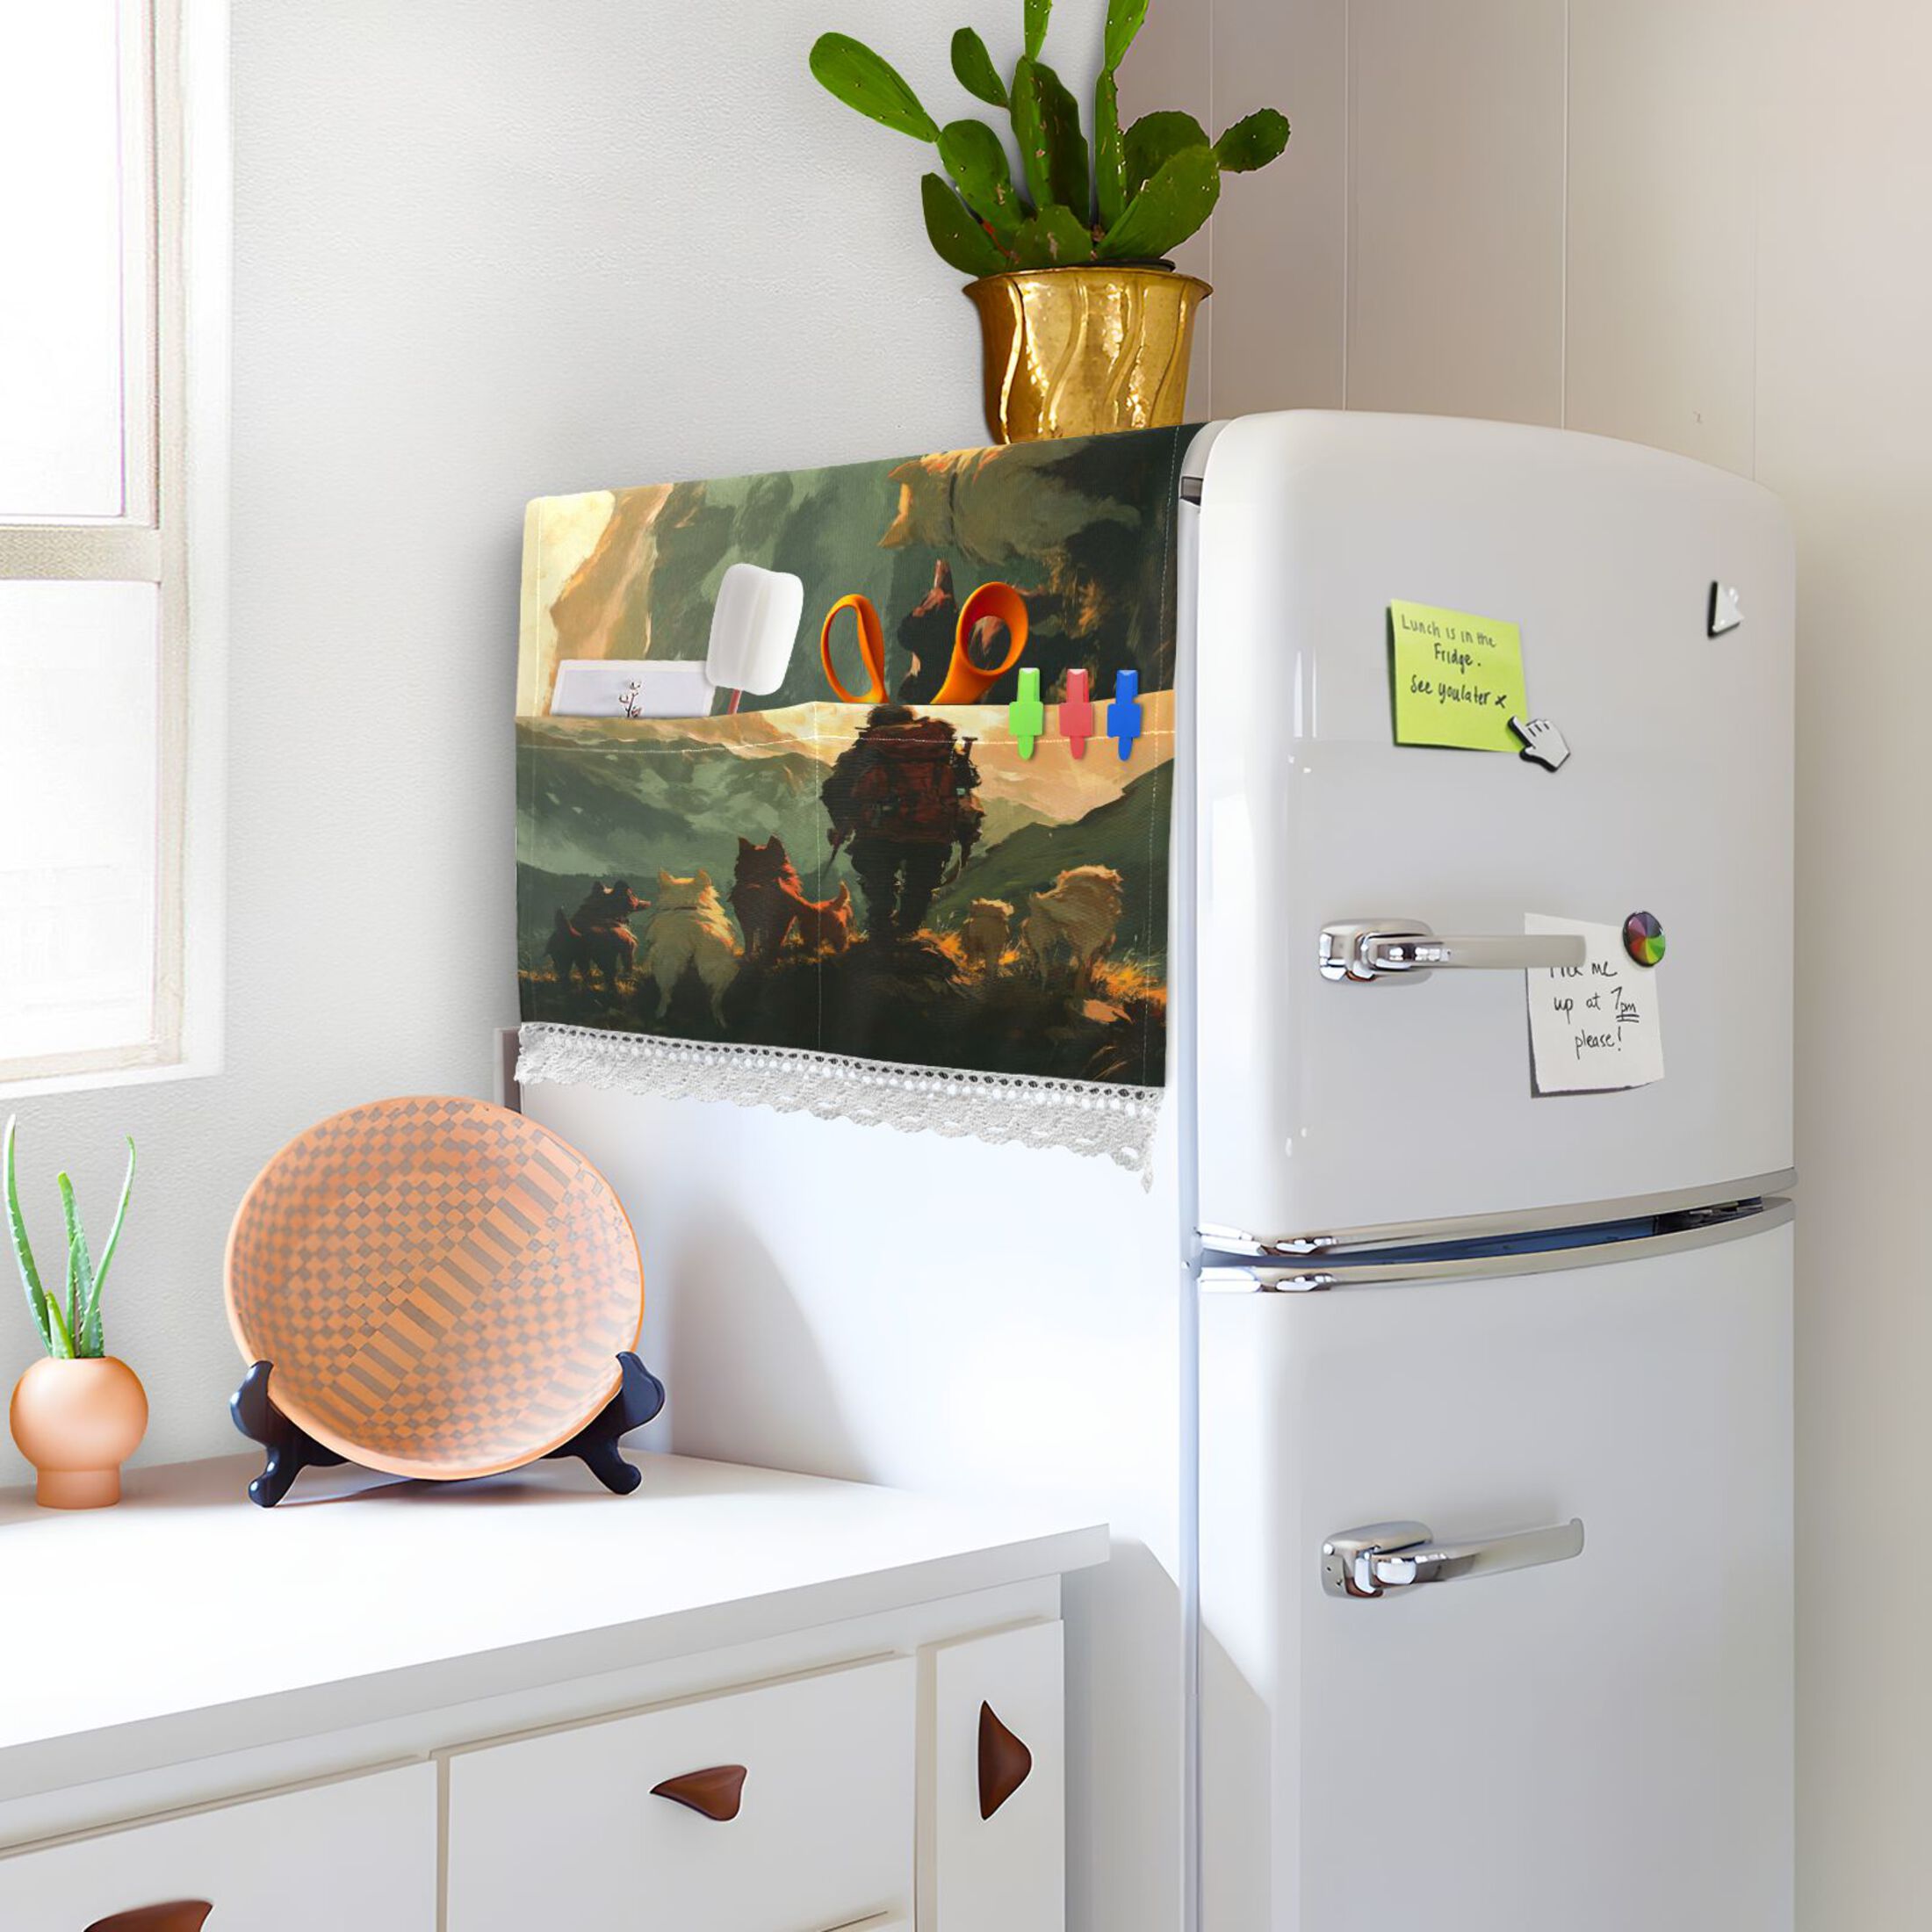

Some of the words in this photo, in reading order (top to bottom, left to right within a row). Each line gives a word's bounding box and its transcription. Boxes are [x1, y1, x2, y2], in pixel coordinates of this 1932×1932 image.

[1402, 614, 1441, 639] Lunch
[1445, 627, 1456, 640] is
[1461, 631, 1474, 644] in
[1477, 631, 1496, 648] the
[1410, 674, 1433, 695] See
[1591, 961, 1618, 977] me
[1554, 996, 1574, 1025] up
[1586, 992, 1601, 1011] at
[1575, 1026, 1622, 1061] please!
